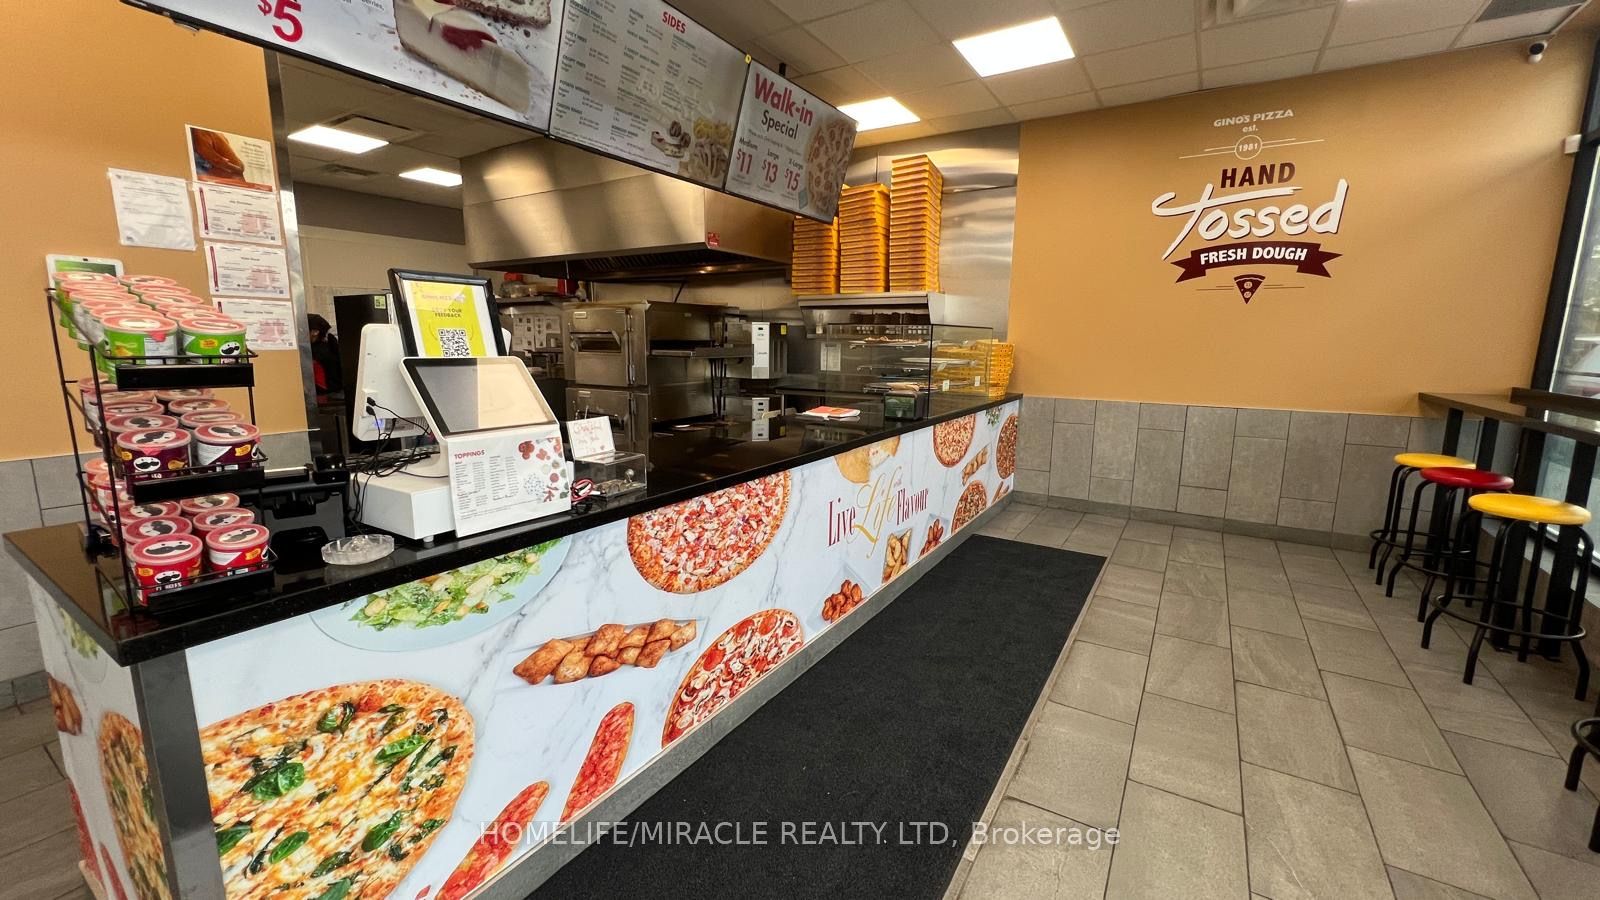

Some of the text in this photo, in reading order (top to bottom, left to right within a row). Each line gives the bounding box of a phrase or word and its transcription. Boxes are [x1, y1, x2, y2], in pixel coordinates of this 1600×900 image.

[662, 11, 686, 34] SIDES
[754, 72, 814, 126] Walk-in
[761, 109, 799, 140] Special
[1253, 108, 1294, 122] PIZZA
[1242, 124, 1258, 133] est.
[739, 137, 758, 151] Medium
[1238, 142, 1258, 152] 1981
[736, 148, 753, 175] $11
[762, 159, 778, 183] $13
[784, 168, 800, 191] $15
[1220, 162, 1296, 188] HAND
[1200, 247, 1308, 265] FRESH DOUGH
[454, 449, 485, 460] TOPPINGS
[828, 497, 856, 547] Live
[896, 488, 928, 525] Flavour
